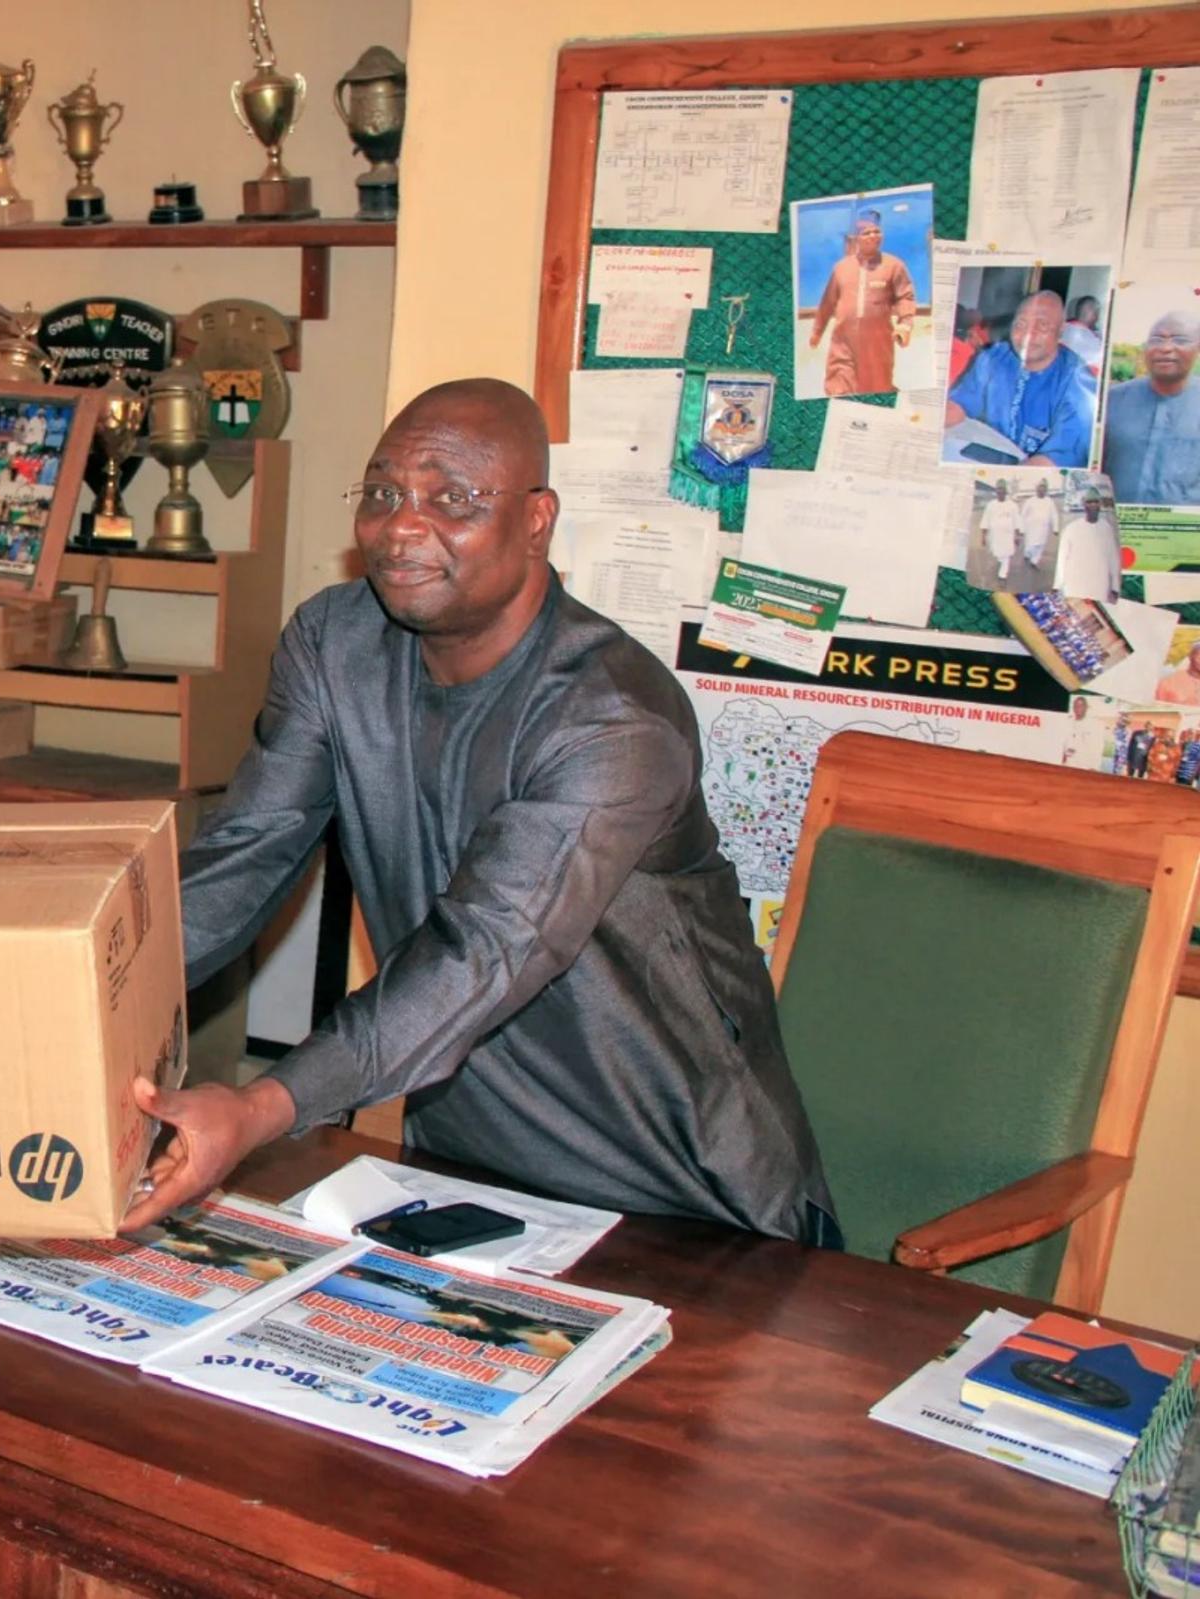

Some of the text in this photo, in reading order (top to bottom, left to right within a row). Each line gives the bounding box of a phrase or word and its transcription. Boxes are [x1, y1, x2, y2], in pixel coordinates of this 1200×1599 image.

[103, 348, 150, 361] CENTRE
[827, 651, 1019, 693] RK PRESS
[695, 678, 1041, 728] SOLID MINERAL RESOURCES DISTRIBUTION IN NIGERIA
[10, 1132, 83, 1202] hp
[298, 1290, 400, 1333] Insecurity
[304, 1314, 504, 1384] Nigeria Laundering
[397, 1321, 485, 1356] Despite
[203, 1354, 320, 1391] Bearer
[920, 1408, 984, 1435] HOSPITAL
